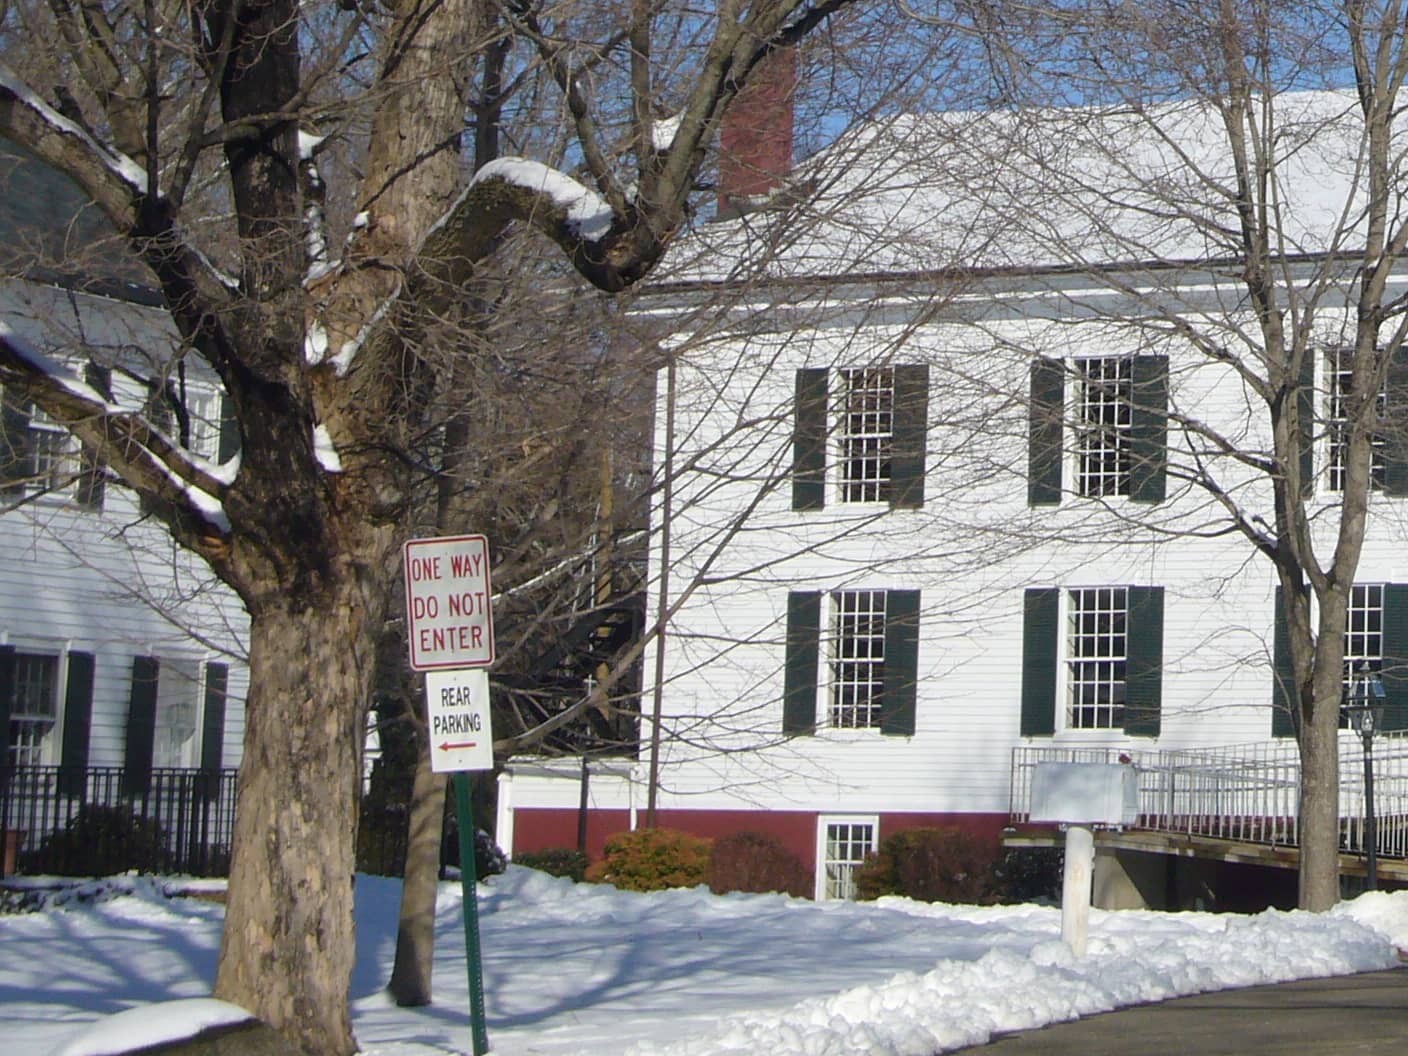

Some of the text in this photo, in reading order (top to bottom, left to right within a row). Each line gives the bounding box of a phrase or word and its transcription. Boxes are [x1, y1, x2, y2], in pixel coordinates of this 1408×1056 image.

[412, 553, 482, 581] ONE WAY
[414, 592, 484, 619] DO NOT
[420, 625, 482, 652] ENTER
[441, 686, 471, 707] REAR
[433, 713, 481, 735] PARKING
